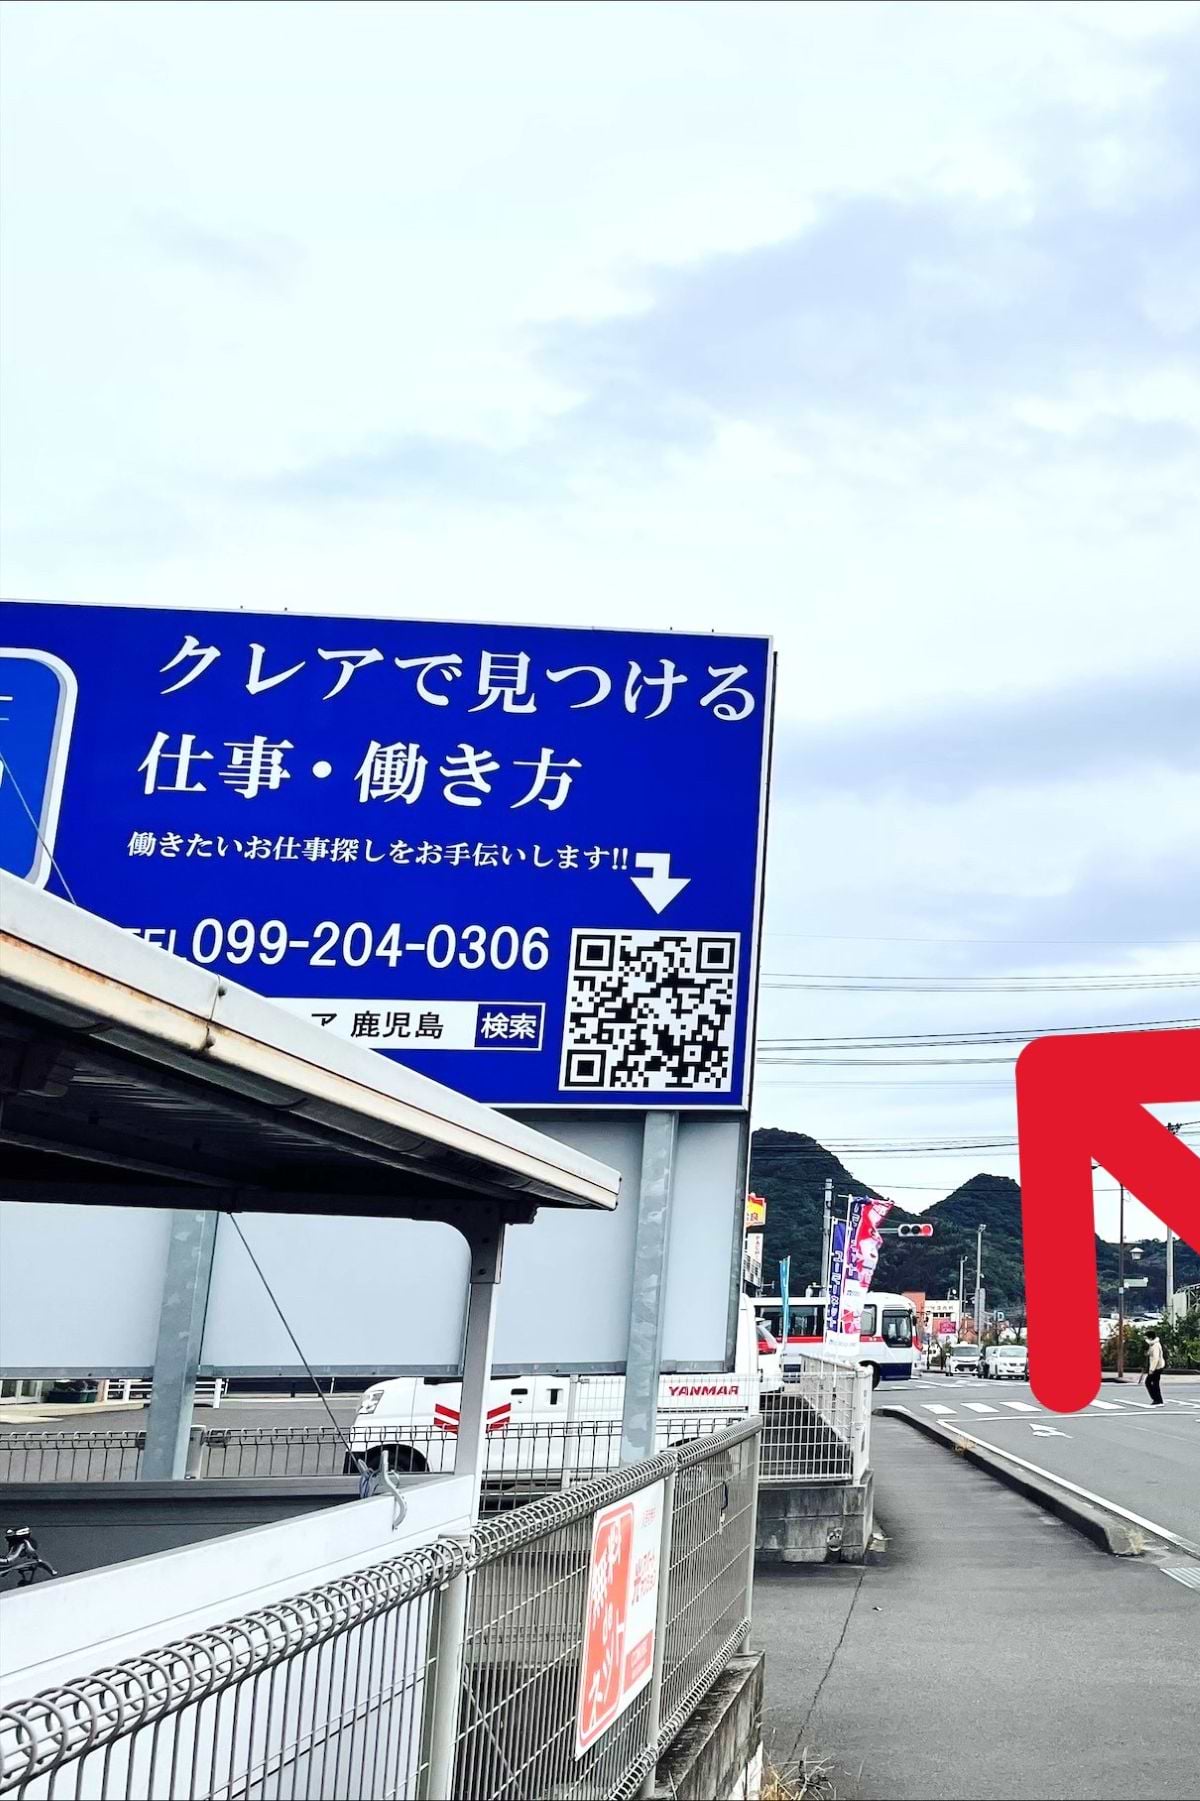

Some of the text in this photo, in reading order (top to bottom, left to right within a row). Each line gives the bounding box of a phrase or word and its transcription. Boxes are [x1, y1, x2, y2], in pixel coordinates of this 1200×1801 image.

[159, 634, 756, 721] クレアで見つける
[137, 730, 583, 811] 仕事・働き方
[127, 830, 629, 871] 働きたいお仕事探しをお手伝いします!!
[192, 917, 550, 971] 099-204-0306
[349, 1011, 445, 1039] 鹿児島
[480, 1011, 537, 1040] 検索
[668, 1385, 739, 1397] YANMAR
